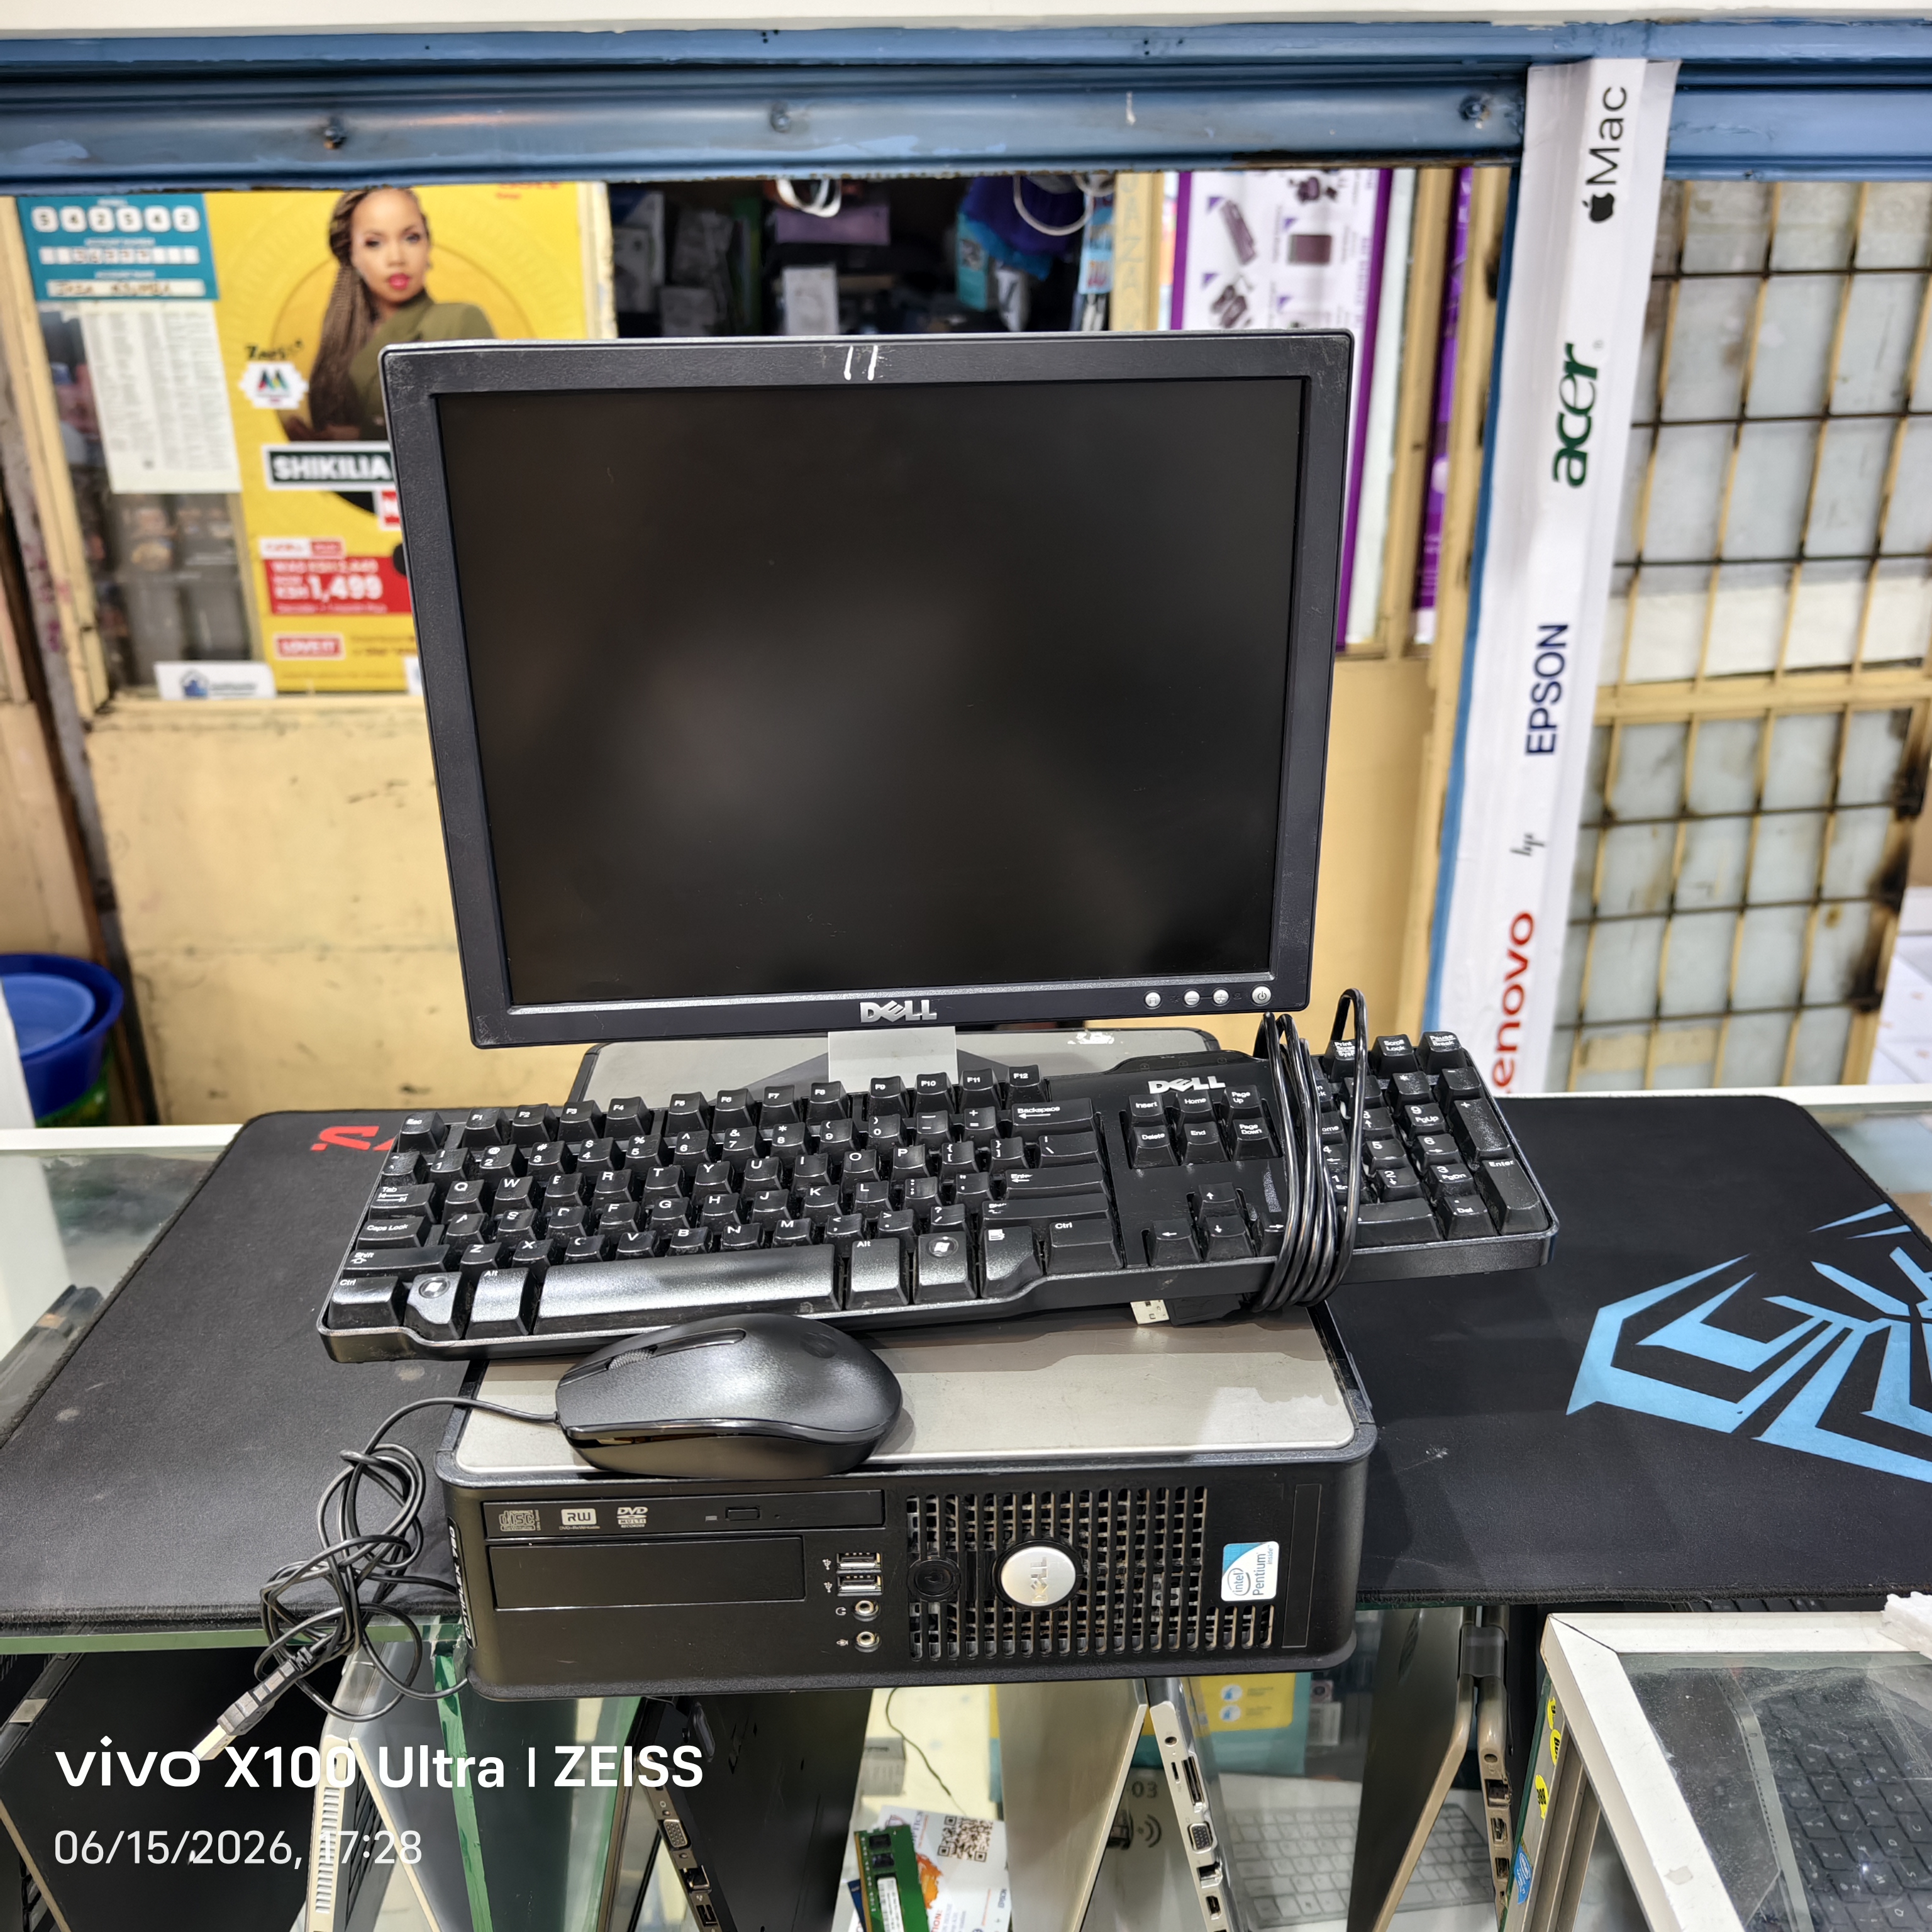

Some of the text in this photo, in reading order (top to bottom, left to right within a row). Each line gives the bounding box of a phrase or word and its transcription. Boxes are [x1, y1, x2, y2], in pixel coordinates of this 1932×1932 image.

[1585, 87, 1627, 185] Mac
[1552, 341, 1598, 489] acer
[1525, 624, 1569, 756] EPSON
[1492, 909, 1535, 1092] enovo
[860, 1000, 937, 1023] DELL
[1148, 1075, 1226, 1094] DELL
[898, 1148, 908, 1157] P
[704, 1164, 714, 1172] Y
[752, 1160, 762, 1169] U
[602, 1172, 613, 1180] R
[653, 1169, 663, 1177] T
[455, 1182, 468, 1191] Q
[504, 1179, 520, 1187] W
[608, 1204, 619, 1212] F
[659, 1200, 671, 1208] G
[567, 1513, 591, 1521] RW
[1252, 1553, 1266, 1596] Pentium
[1030, 1557, 1048, 1604] DELL
[1233, 1572, 1244, 1592] intel
